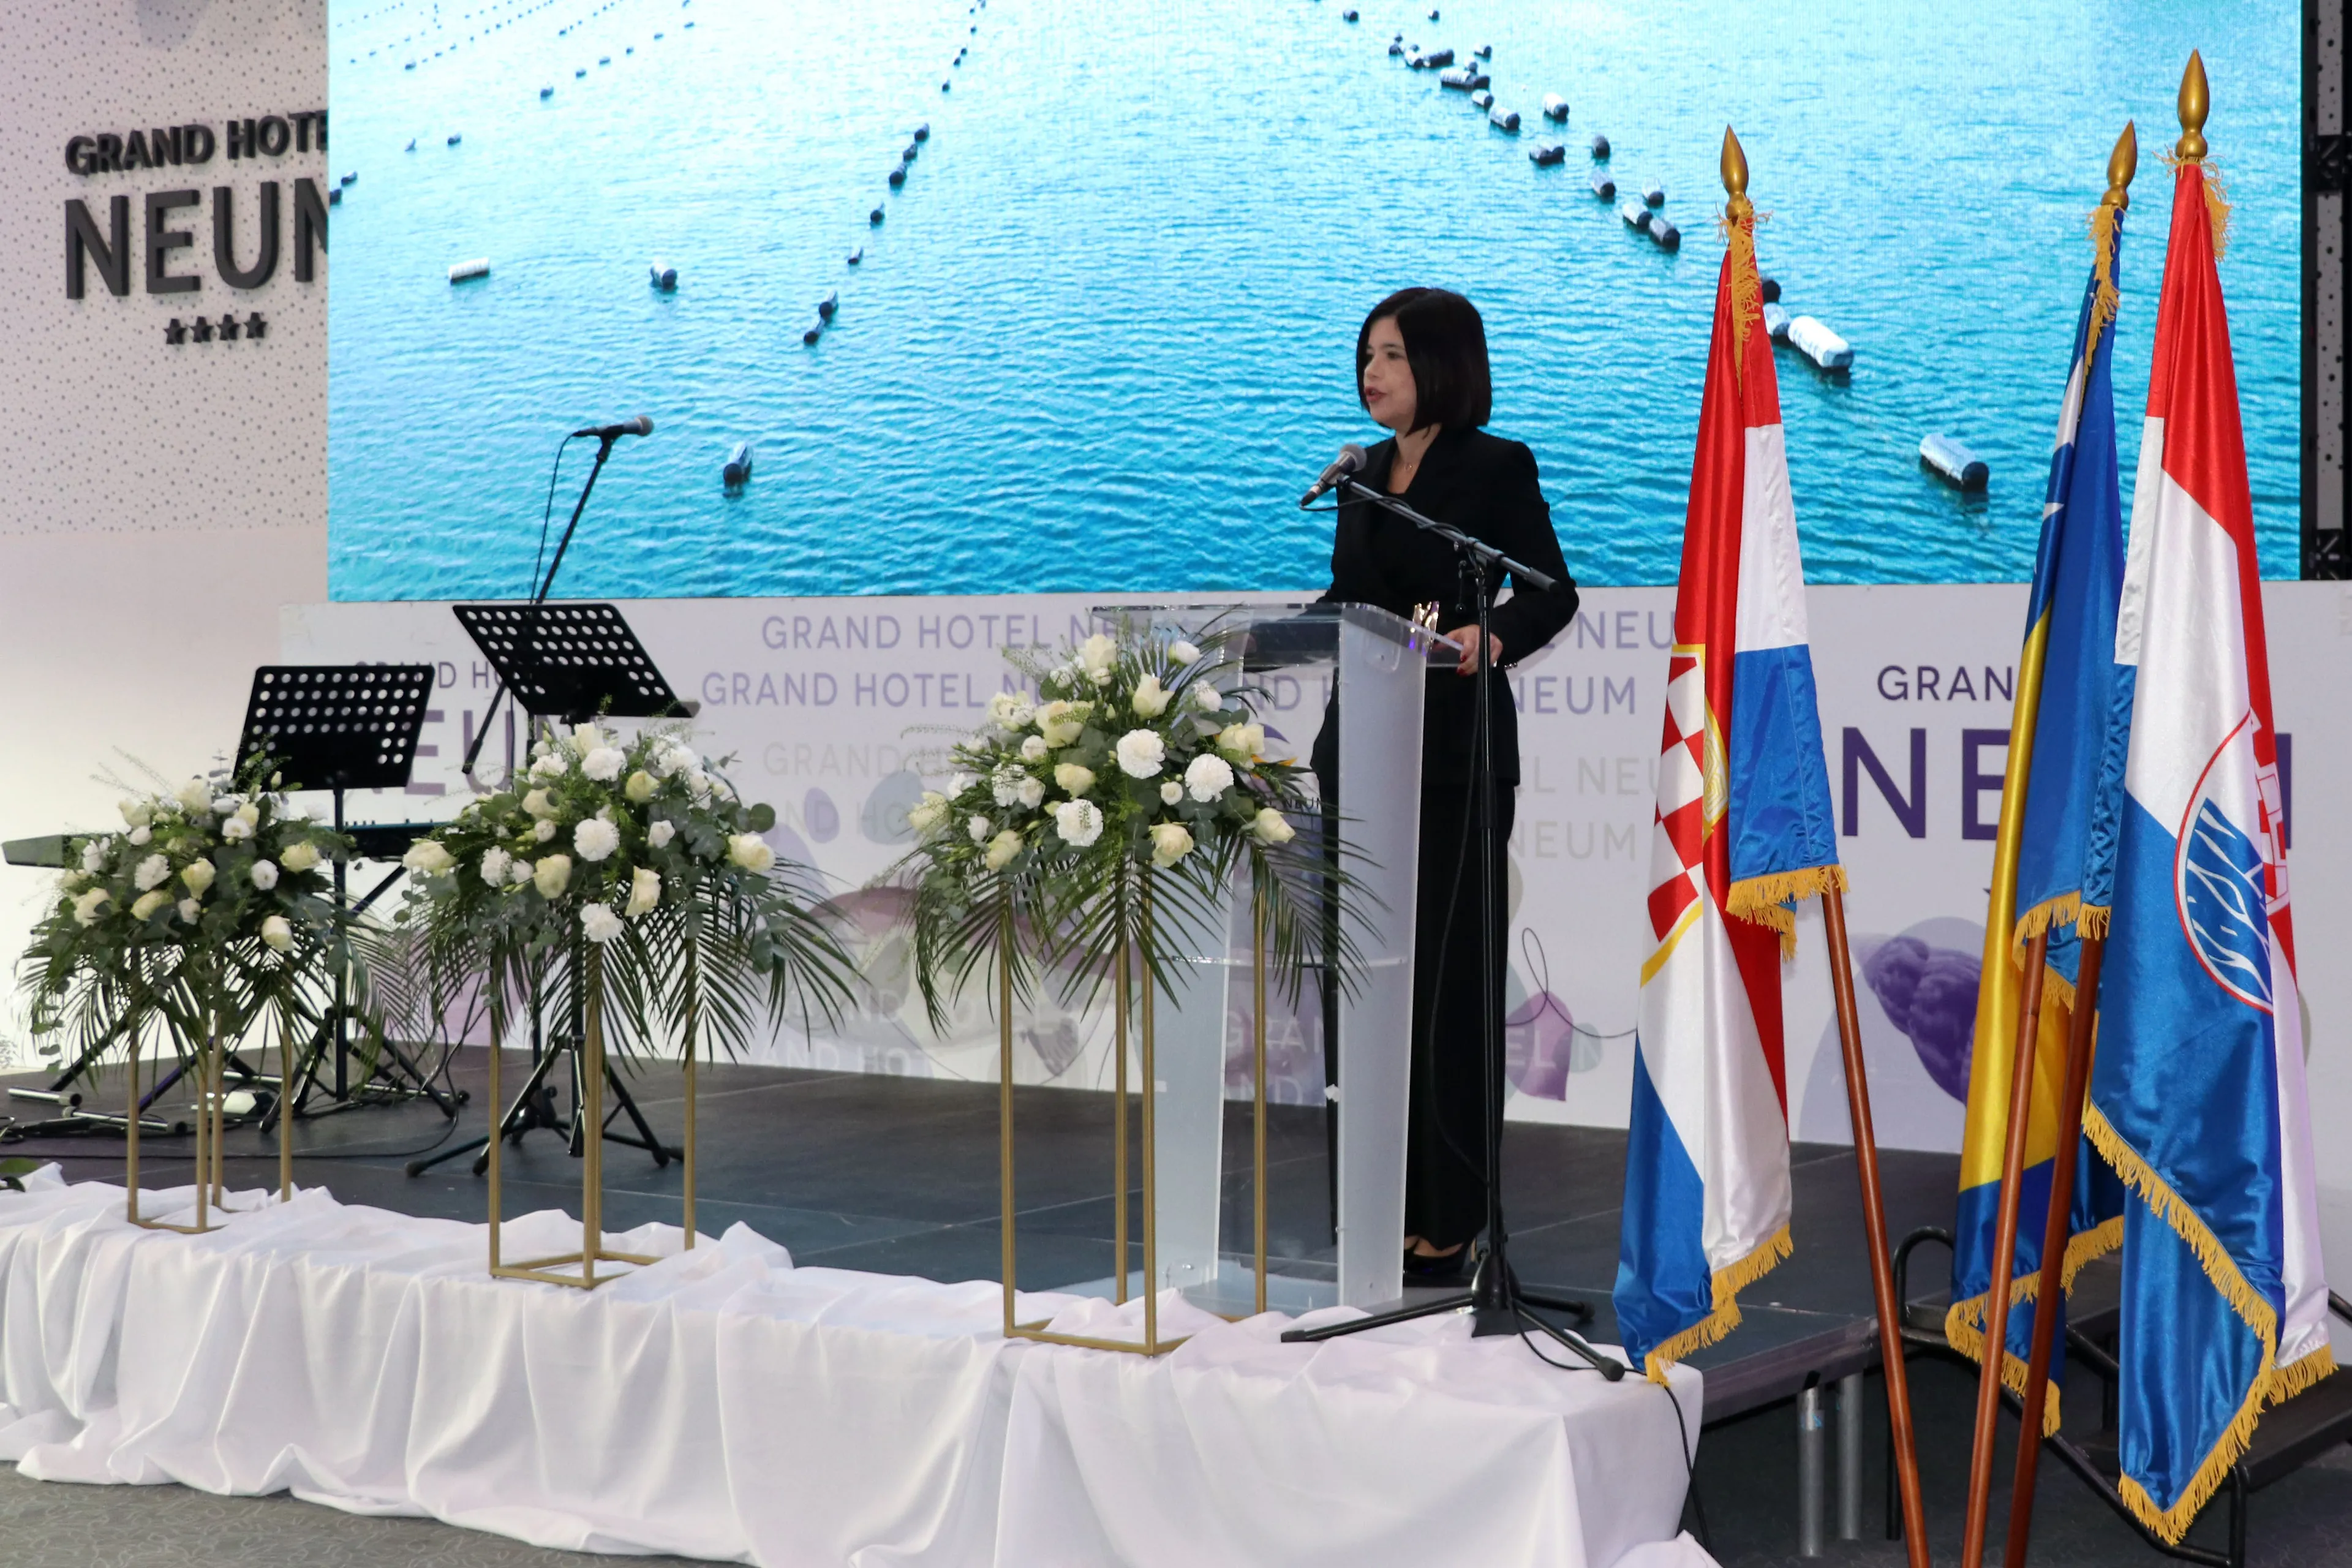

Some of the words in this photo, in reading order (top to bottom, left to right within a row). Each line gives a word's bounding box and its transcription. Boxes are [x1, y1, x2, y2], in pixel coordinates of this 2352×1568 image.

[65, 124, 216, 176] GRAND
[227, 110, 328, 160] HOTE
[763, 615, 900, 649] GRAND
[919, 614, 1052, 649] HOTEL
[1577, 611, 1675, 649] NEU
[702, 673, 838, 706] GRAND
[855, 673, 985, 707] HOTEL
[1877, 665, 2013, 701] GRAN
[763, 741, 902, 777] GRAND
